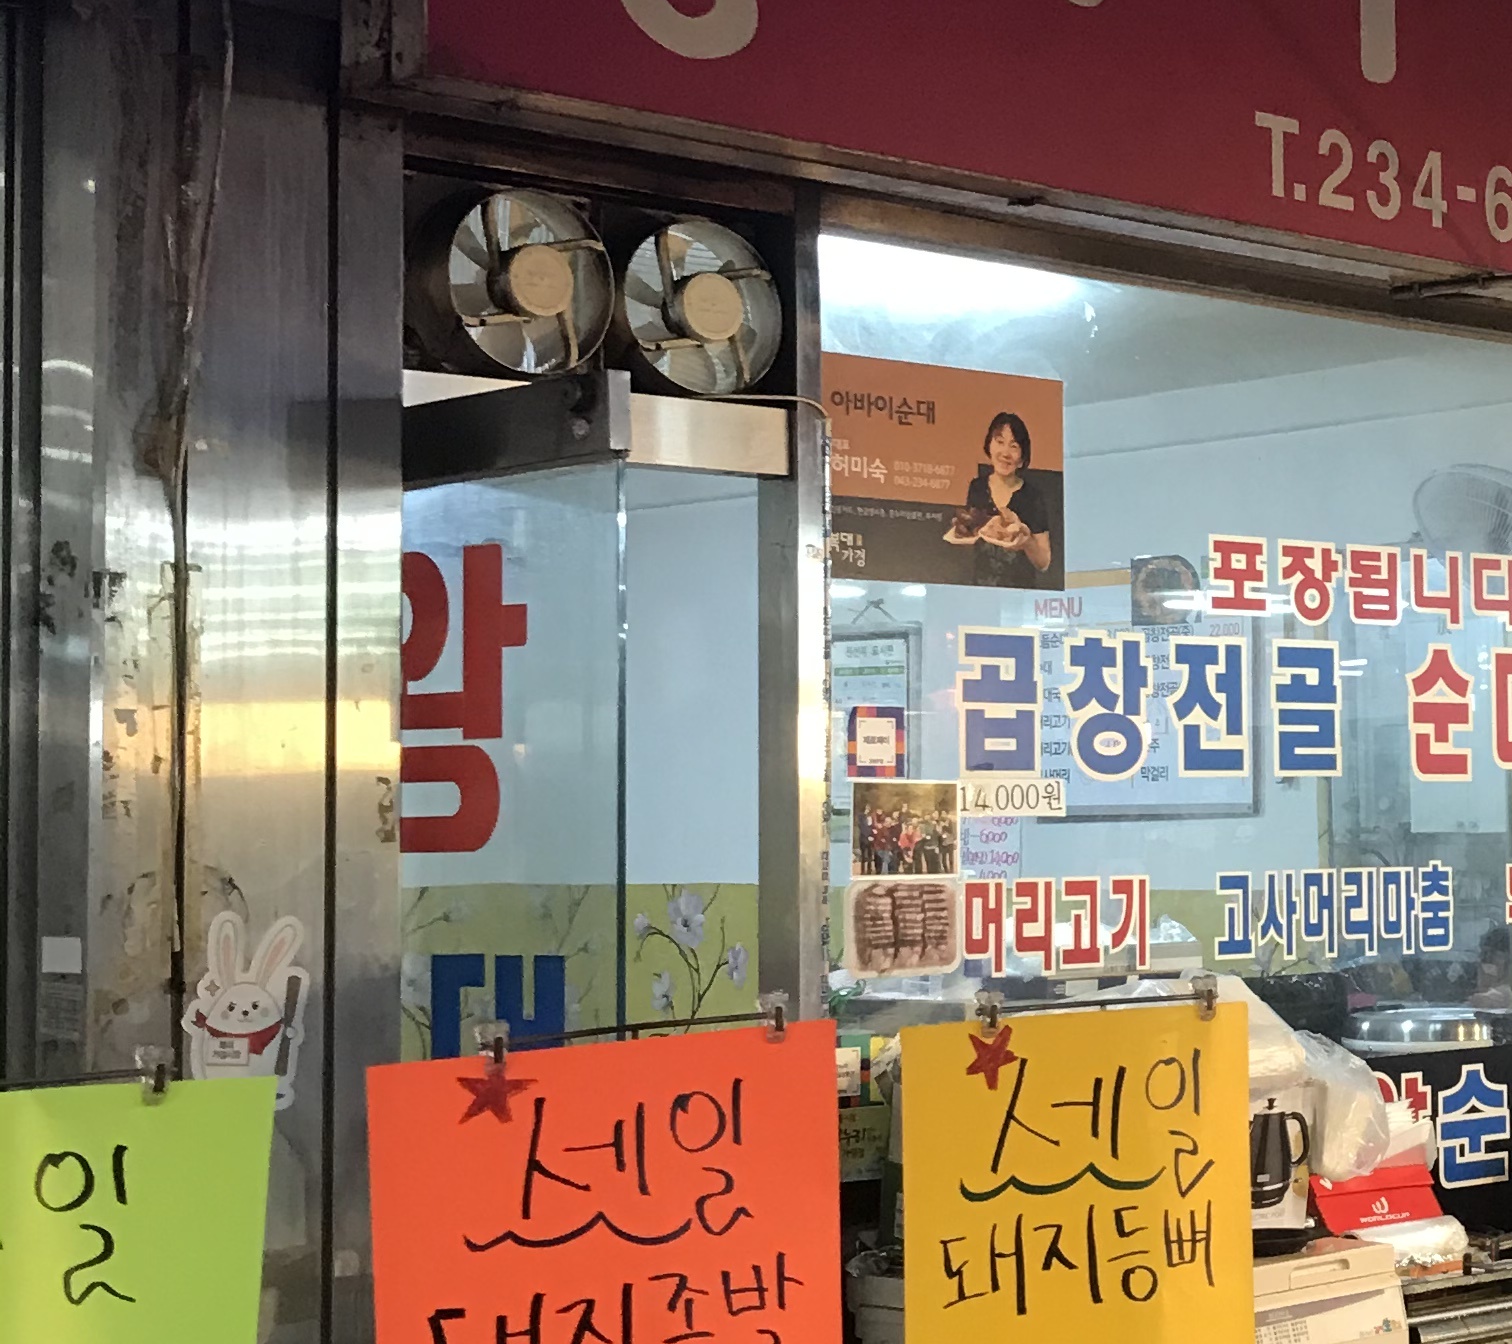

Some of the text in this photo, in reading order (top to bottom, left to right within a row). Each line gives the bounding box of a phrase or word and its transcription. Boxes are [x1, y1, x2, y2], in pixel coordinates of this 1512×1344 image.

[831, 390, 936, 426] 아바이순대
[831, 454, 888, 484] 허미숙
[1034, 596, 1083, 620] MENU
[957, 625, 1343, 782] 곱창전골
[962, 875, 1151, 979] 머리고기
[1213, 859, 1455, 961] 고사머리마춤
[521, 1076, 754, 1236] 세일
[991, 1047, 1215, 1198] 세일
[35, 1143, 136, 1306] 일
[940, 1199, 1215, 1316] 돼지등뼈
